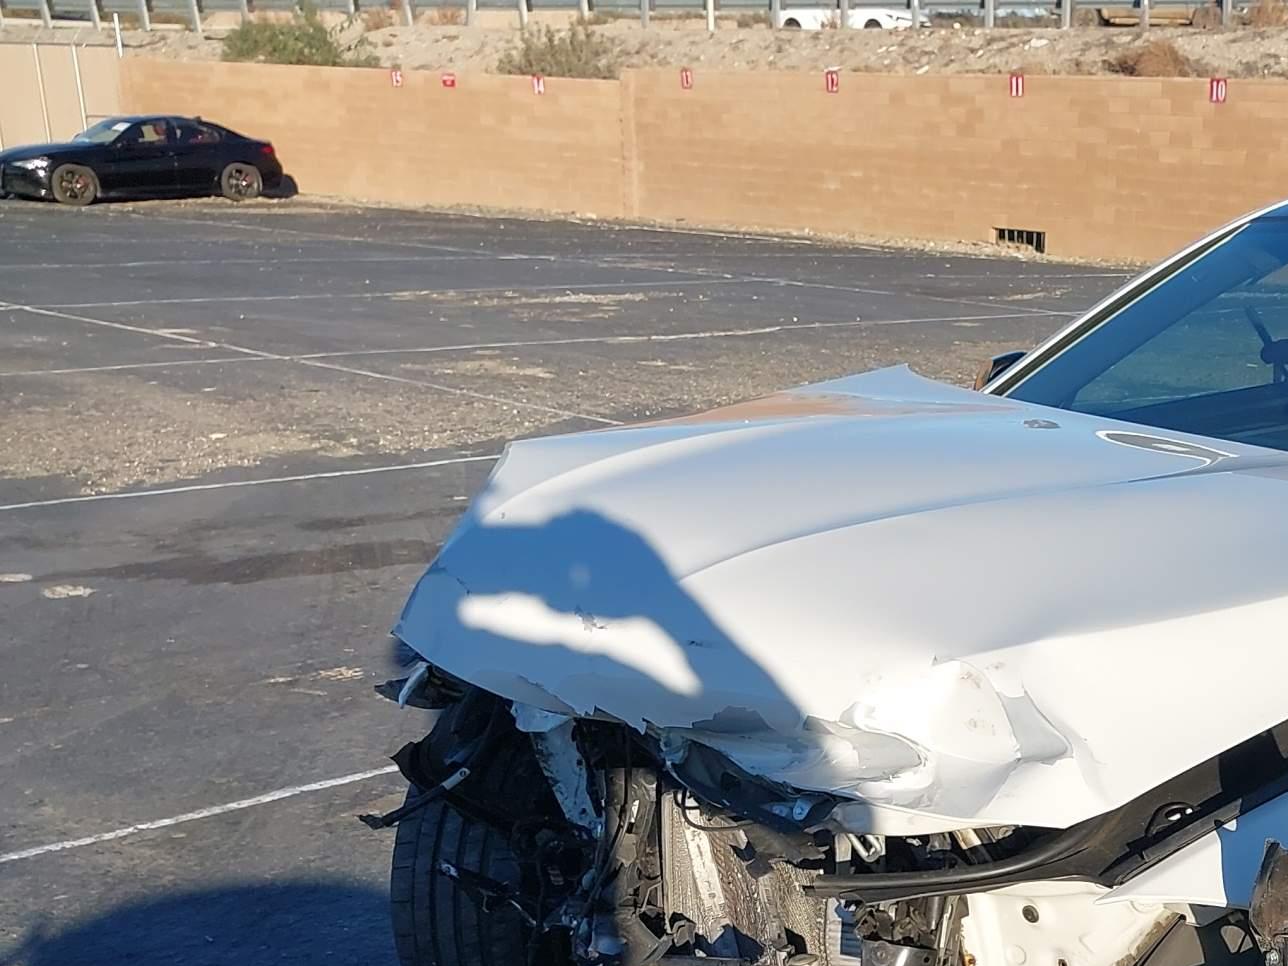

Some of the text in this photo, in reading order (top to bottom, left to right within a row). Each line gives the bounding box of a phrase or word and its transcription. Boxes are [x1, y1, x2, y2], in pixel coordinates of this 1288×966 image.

[827, 73, 838, 91] 12
[1011, 76, 1023, 97] 11
[1211, 80, 1226, 102] 10
